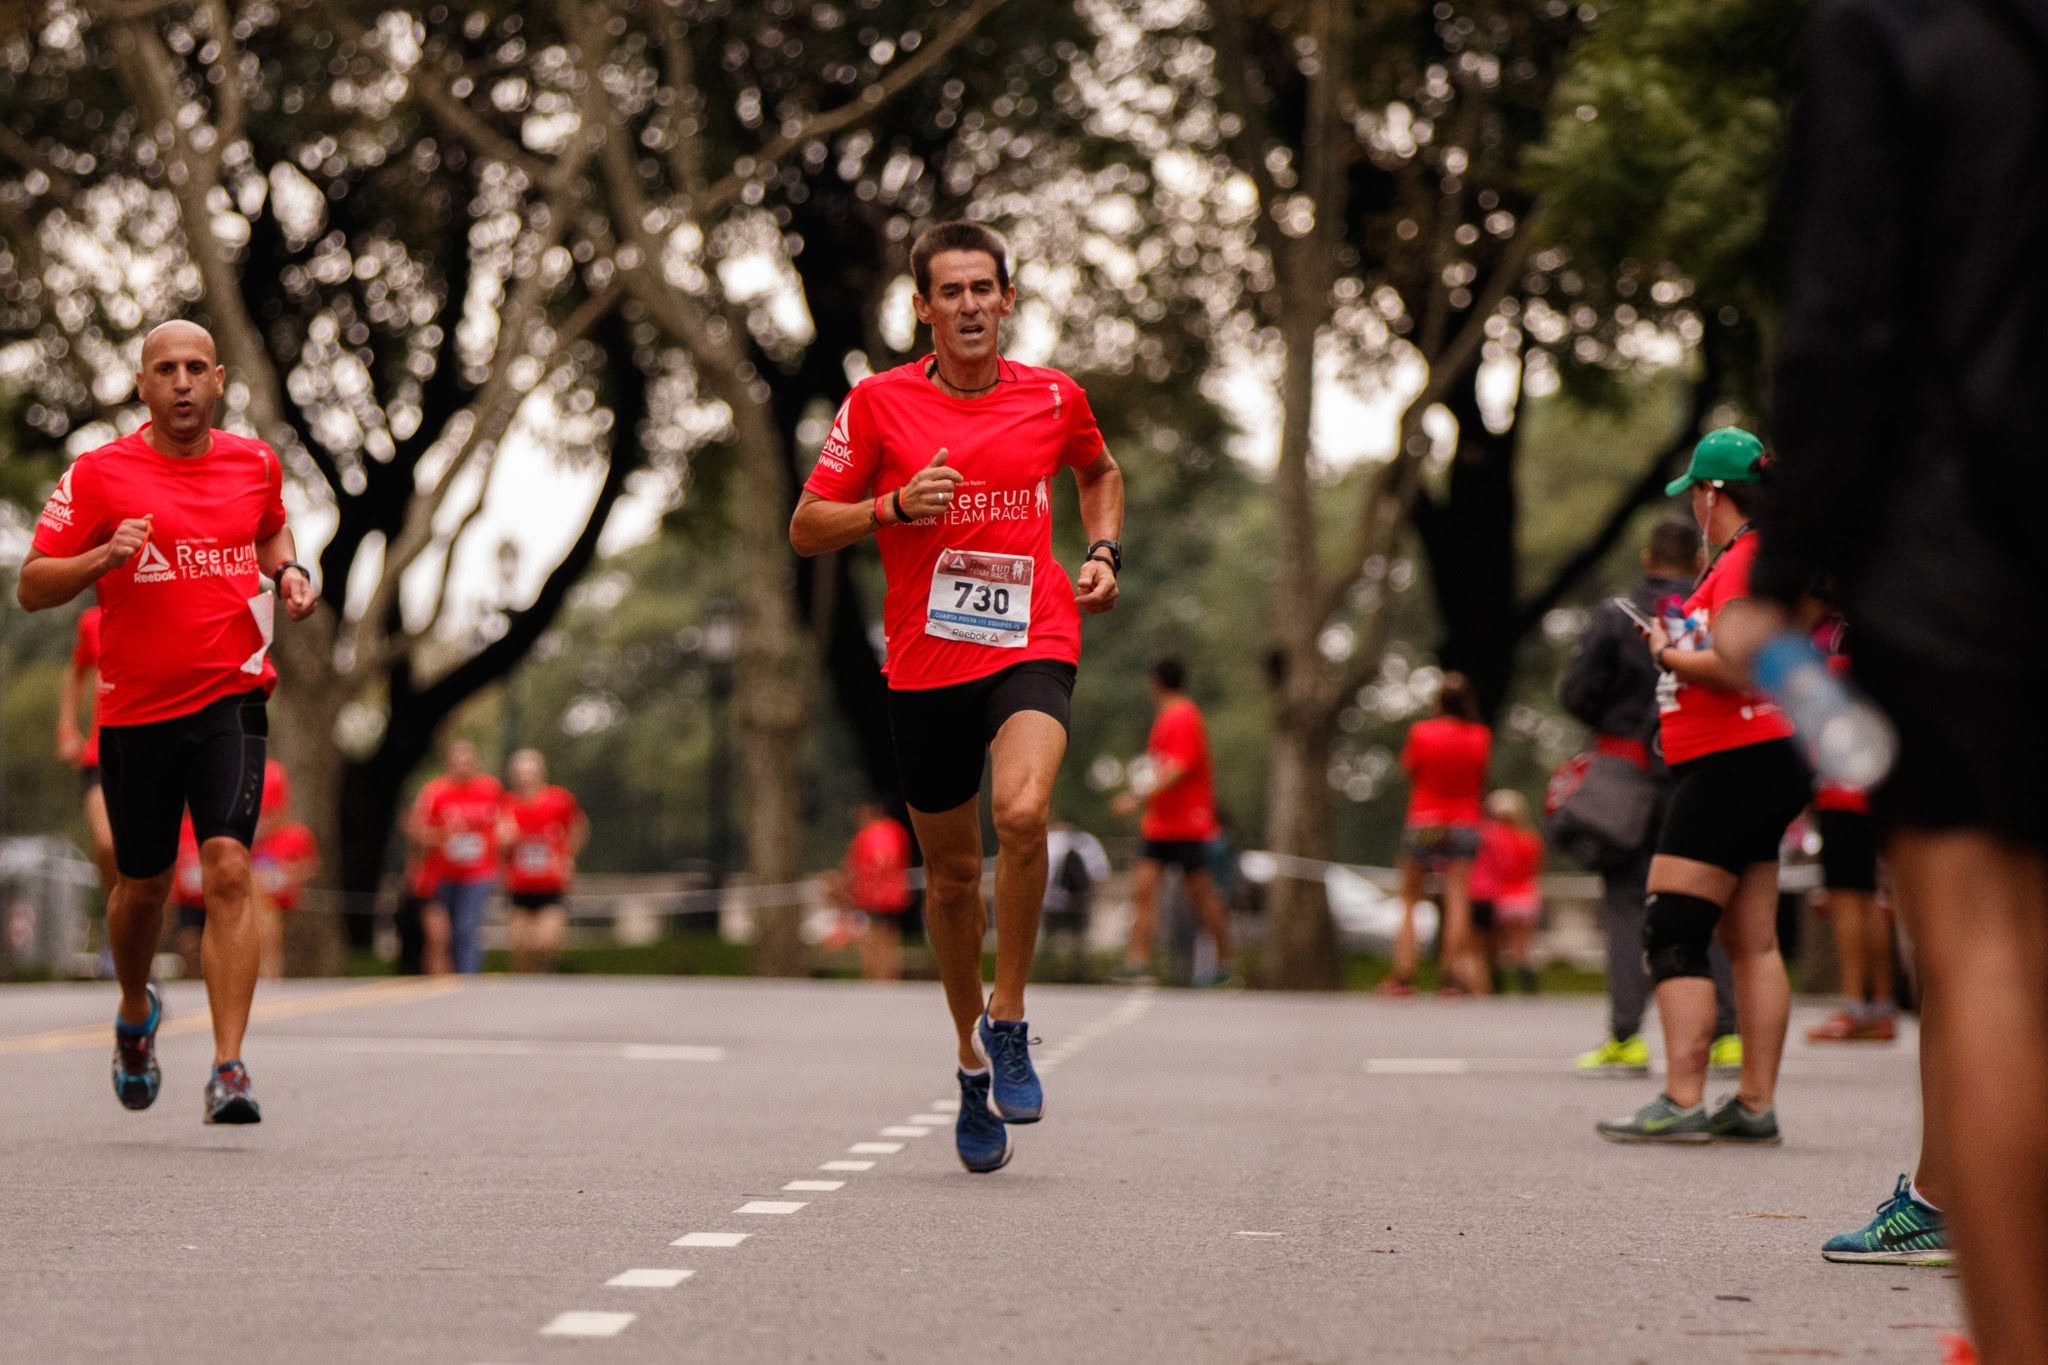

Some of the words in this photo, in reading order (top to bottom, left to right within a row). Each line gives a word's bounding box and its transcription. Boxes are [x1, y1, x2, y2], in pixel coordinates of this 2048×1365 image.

[944, 510, 985, 525] TEAM
[990, 505, 1029, 521] RACE
[176, 544, 253, 566] Reerun
[133, 569, 177, 583] Reebok
[179, 564, 222, 579] TEAM
[223, 560, 254, 577] RACE
[953, 581, 1010, 615] 730
[952, 628, 988, 642] Reebok
